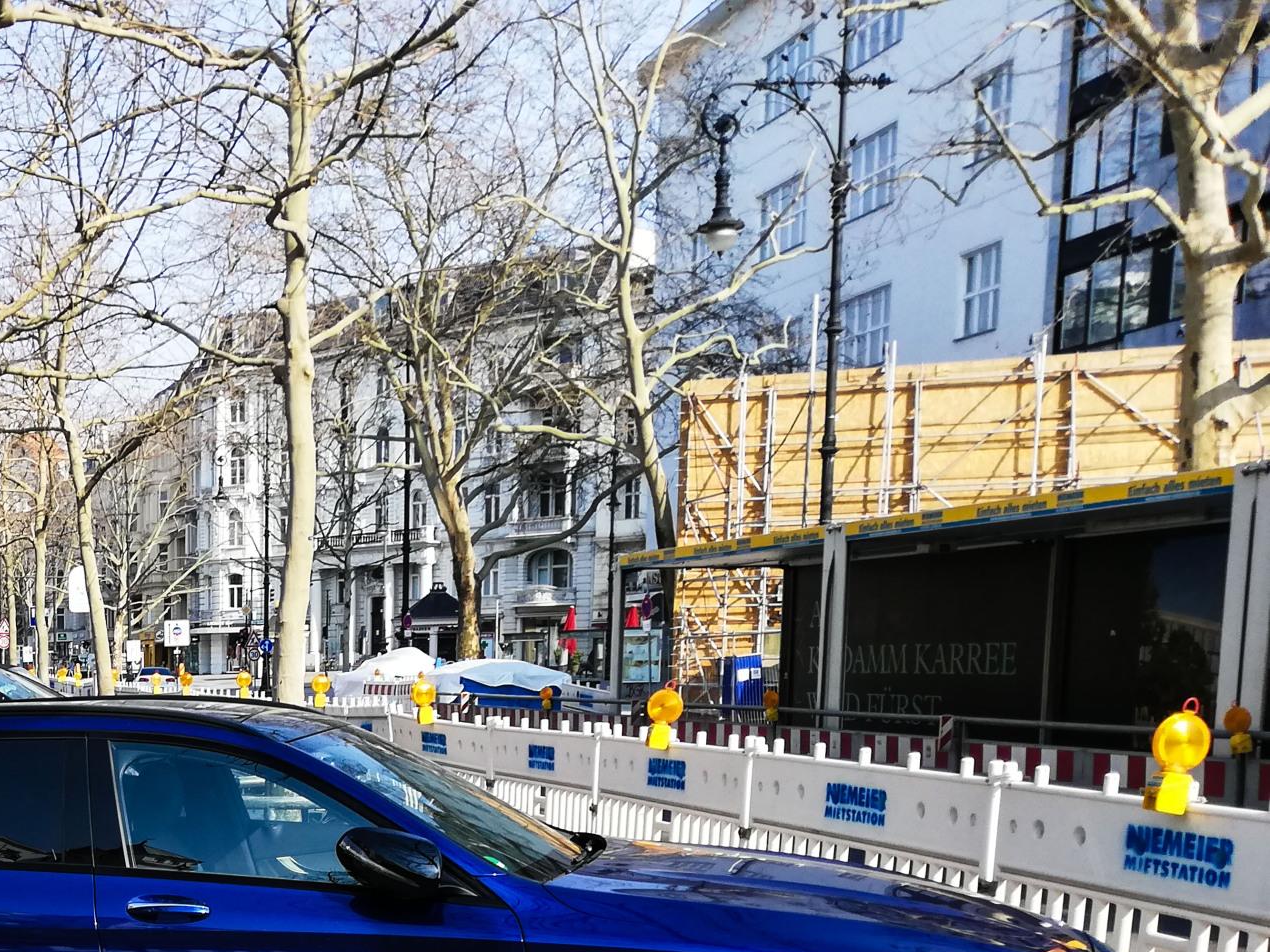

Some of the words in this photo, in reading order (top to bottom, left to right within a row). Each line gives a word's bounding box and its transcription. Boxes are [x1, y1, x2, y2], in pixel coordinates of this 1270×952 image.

[250, 651, 258, 659] 30
[914, 641, 1017, 676] KARREE
[826, 783, 887, 812] NIEMEIER
[824, 805, 885, 827] MIETSTATION
[1126, 824, 1234, 869] NIEMEIER
